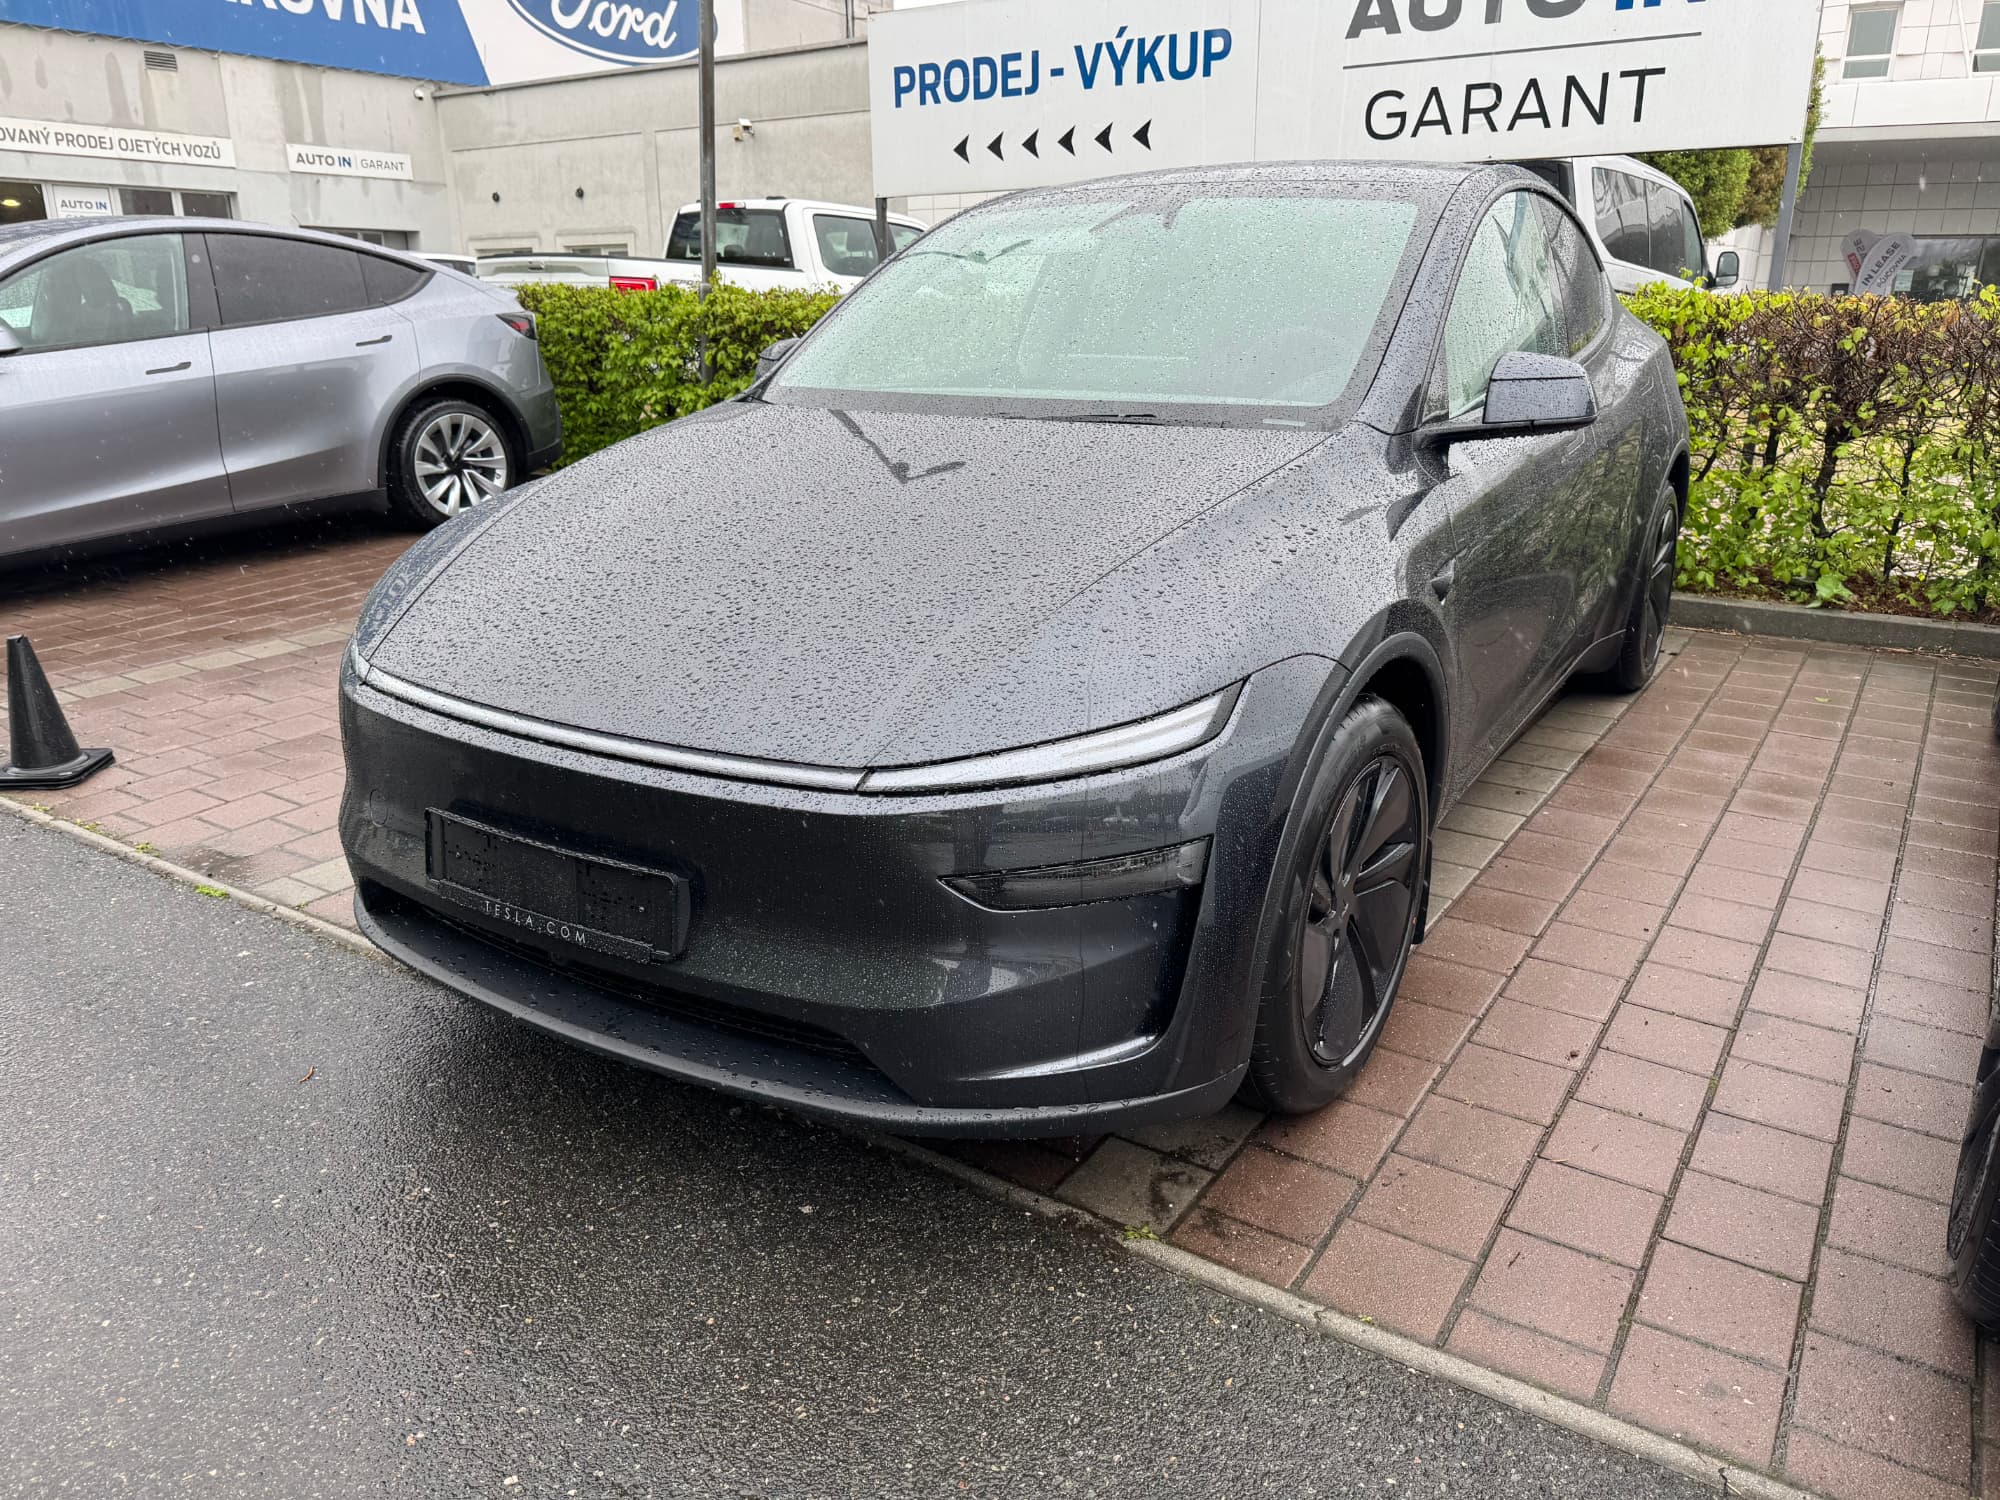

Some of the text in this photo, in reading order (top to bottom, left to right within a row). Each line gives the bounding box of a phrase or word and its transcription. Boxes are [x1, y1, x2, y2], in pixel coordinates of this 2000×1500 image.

[894, 50, 1040, 108] PRODEJ
[1074, 25, 1233, 90] VÝKUP
[1364, 67, 1667, 140] GARANT
[54, 131, 114, 150] PRODEJ
[118, 137, 182, 157] OJETÝCH
[183, 141, 221, 159] VOZŮ
[296, 152, 405, 171] AUTO IN GARANT
[61, 200, 107, 210] AUTO IN
[1861, 241, 1901, 287] IN LEASE
[485, 900, 586, 944] TESLA.COM
